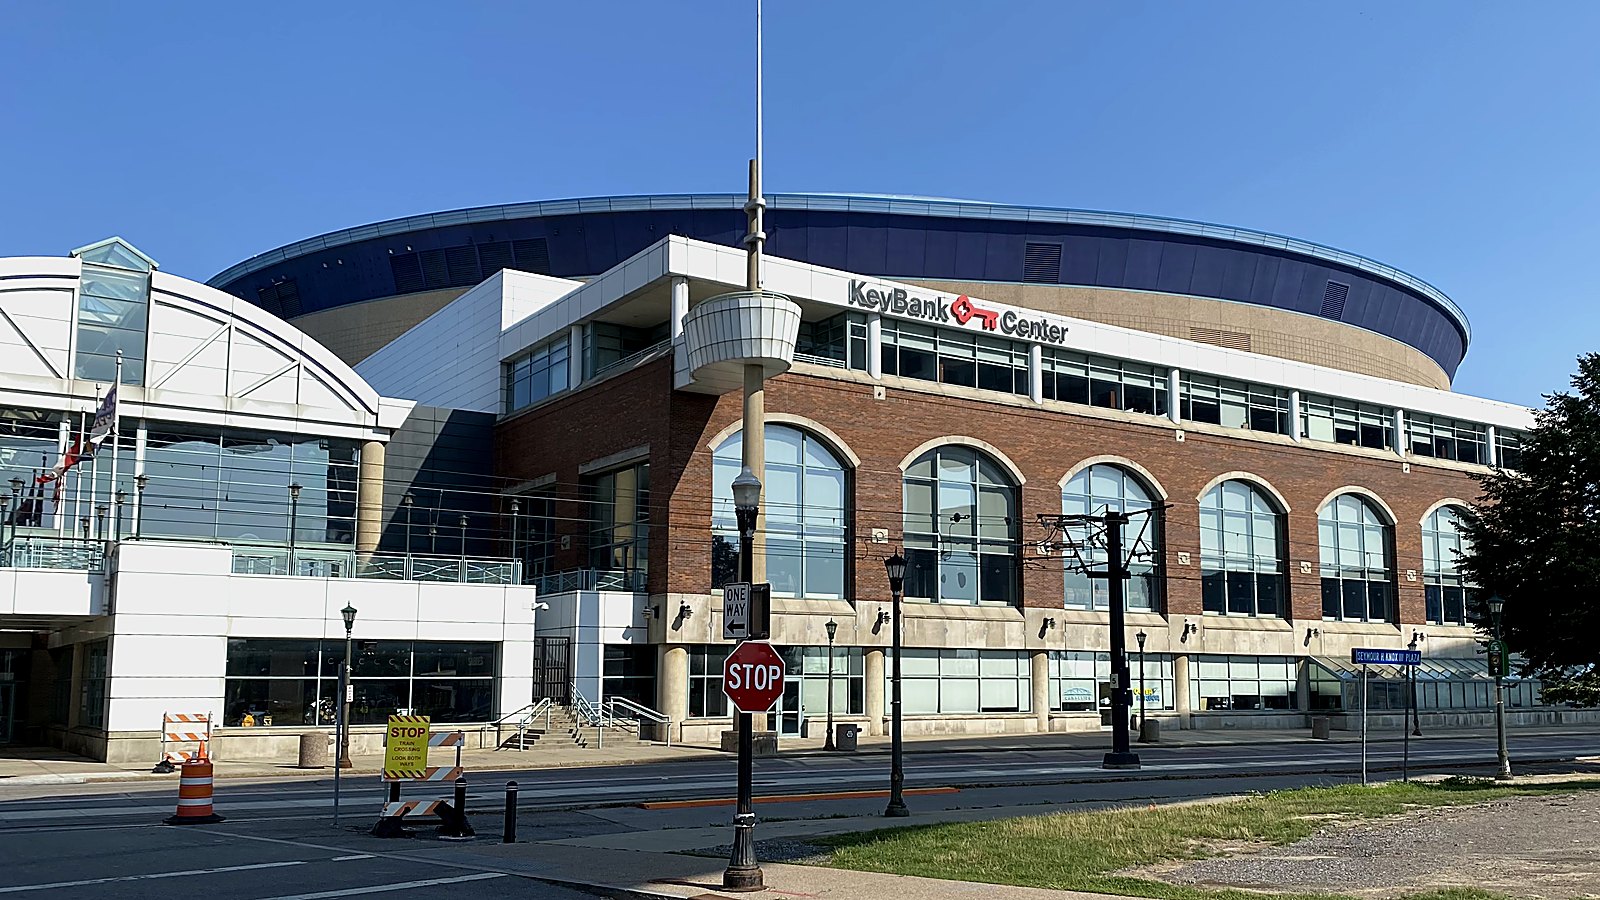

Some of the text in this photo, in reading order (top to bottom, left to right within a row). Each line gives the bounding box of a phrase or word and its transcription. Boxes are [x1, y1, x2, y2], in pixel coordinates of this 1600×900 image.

[848, 279, 1069, 344] KeyBank Center
[727, 587, 746, 602] ONE
[727, 603, 746, 617] WAY
[1358, 652, 1379, 660] SEYMOUR
[1386, 653, 1398, 661] KNOX
[1406, 654, 1420, 662] PLAZA
[728, 663, 781, 691] STOP
[391, 727, 426, 738] STOP
